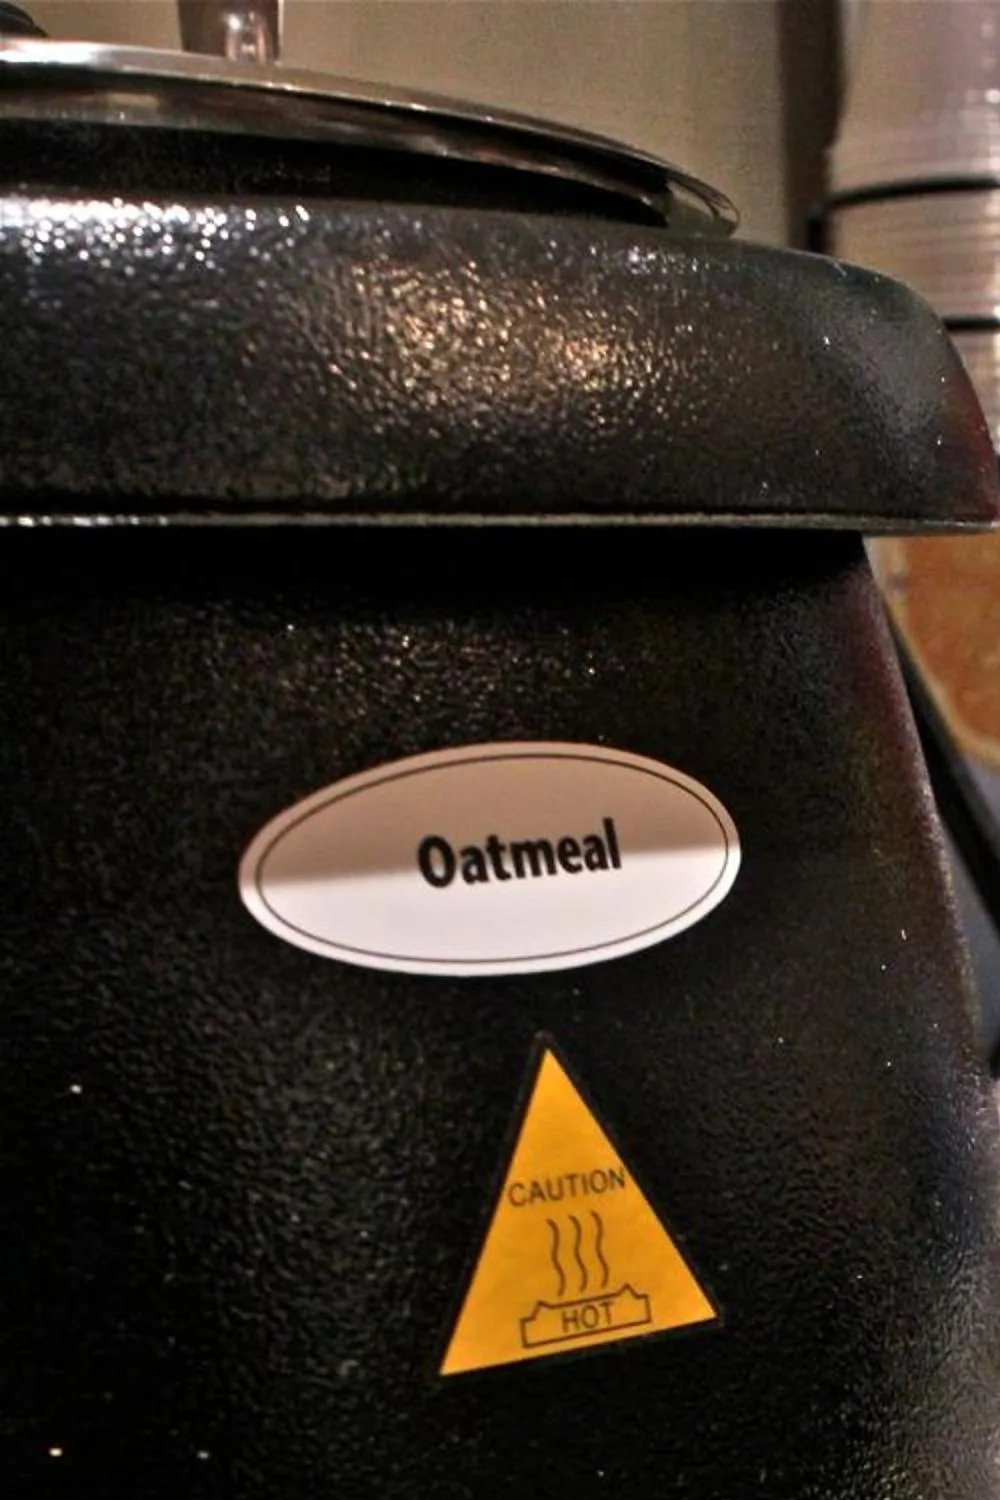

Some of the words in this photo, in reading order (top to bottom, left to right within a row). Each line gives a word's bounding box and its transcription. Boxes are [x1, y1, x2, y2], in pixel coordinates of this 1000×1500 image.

[417, 817, 622, 888] Oatmeal
[508, 1168, 626, 1207] CAUTION
[561, 1301, 615, 1333] HOT
